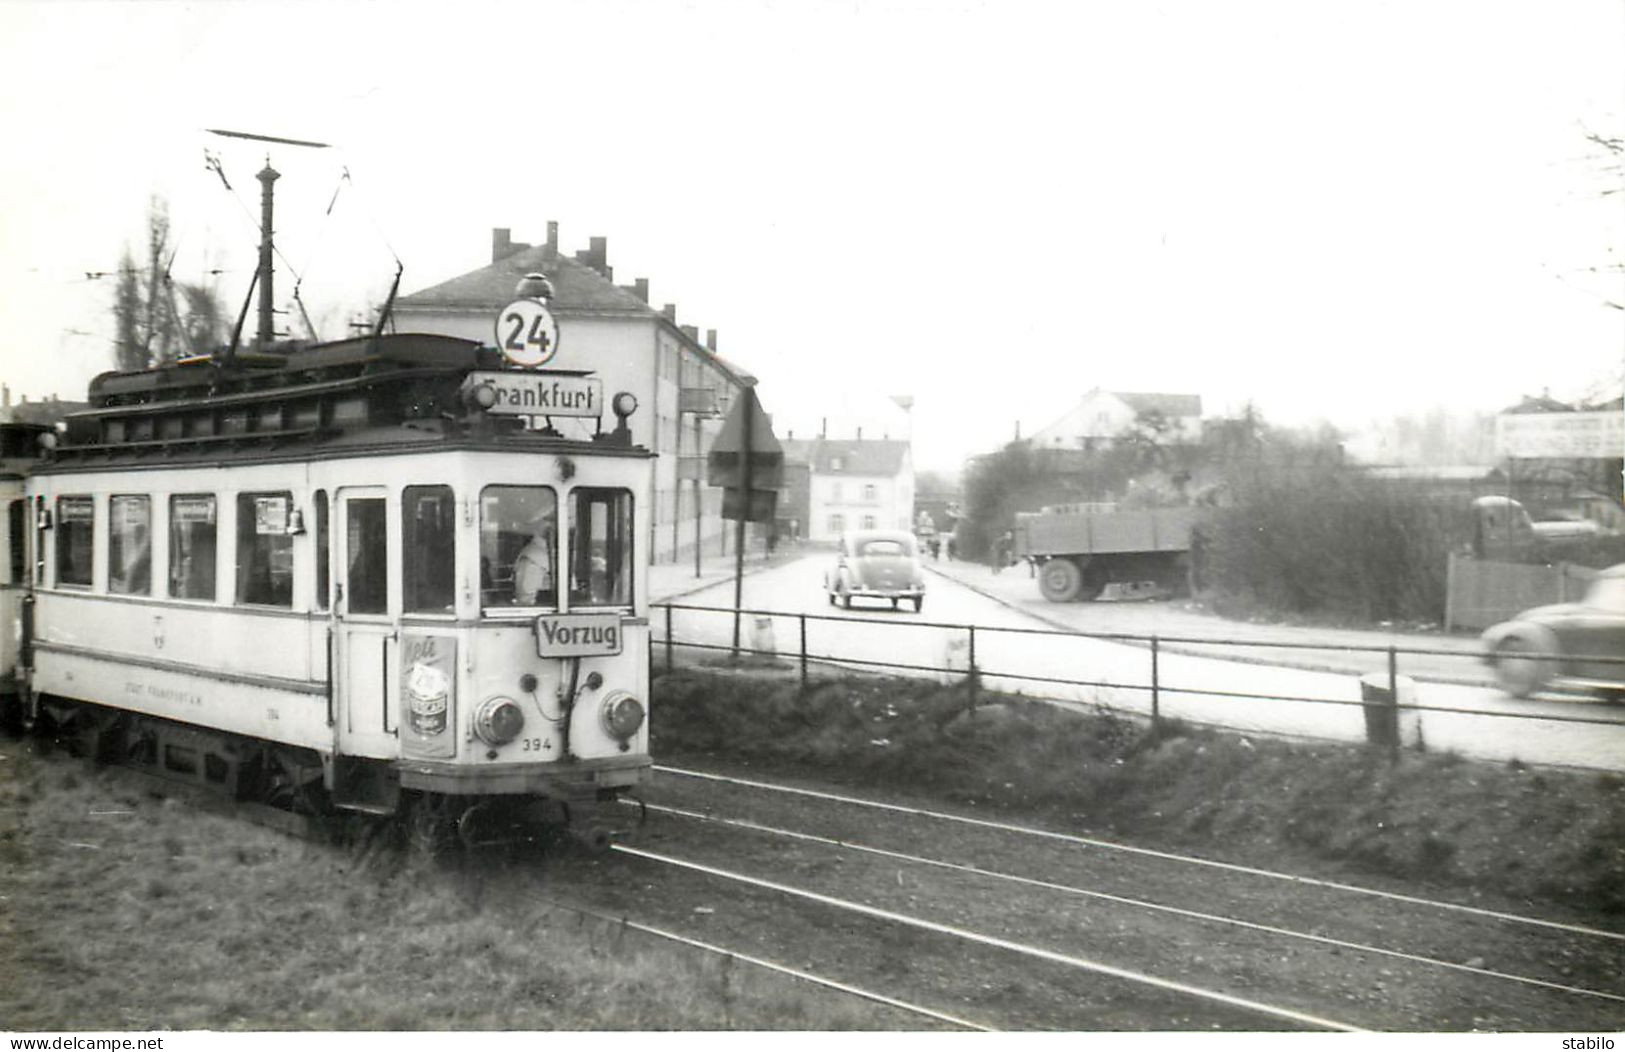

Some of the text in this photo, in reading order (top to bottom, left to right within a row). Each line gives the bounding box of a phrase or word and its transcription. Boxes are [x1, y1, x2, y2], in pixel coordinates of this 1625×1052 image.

[505, 313, 550, 352] 24
[541, 620, 617, 648] Vorzug
[522, 738, 552, 751] 394
